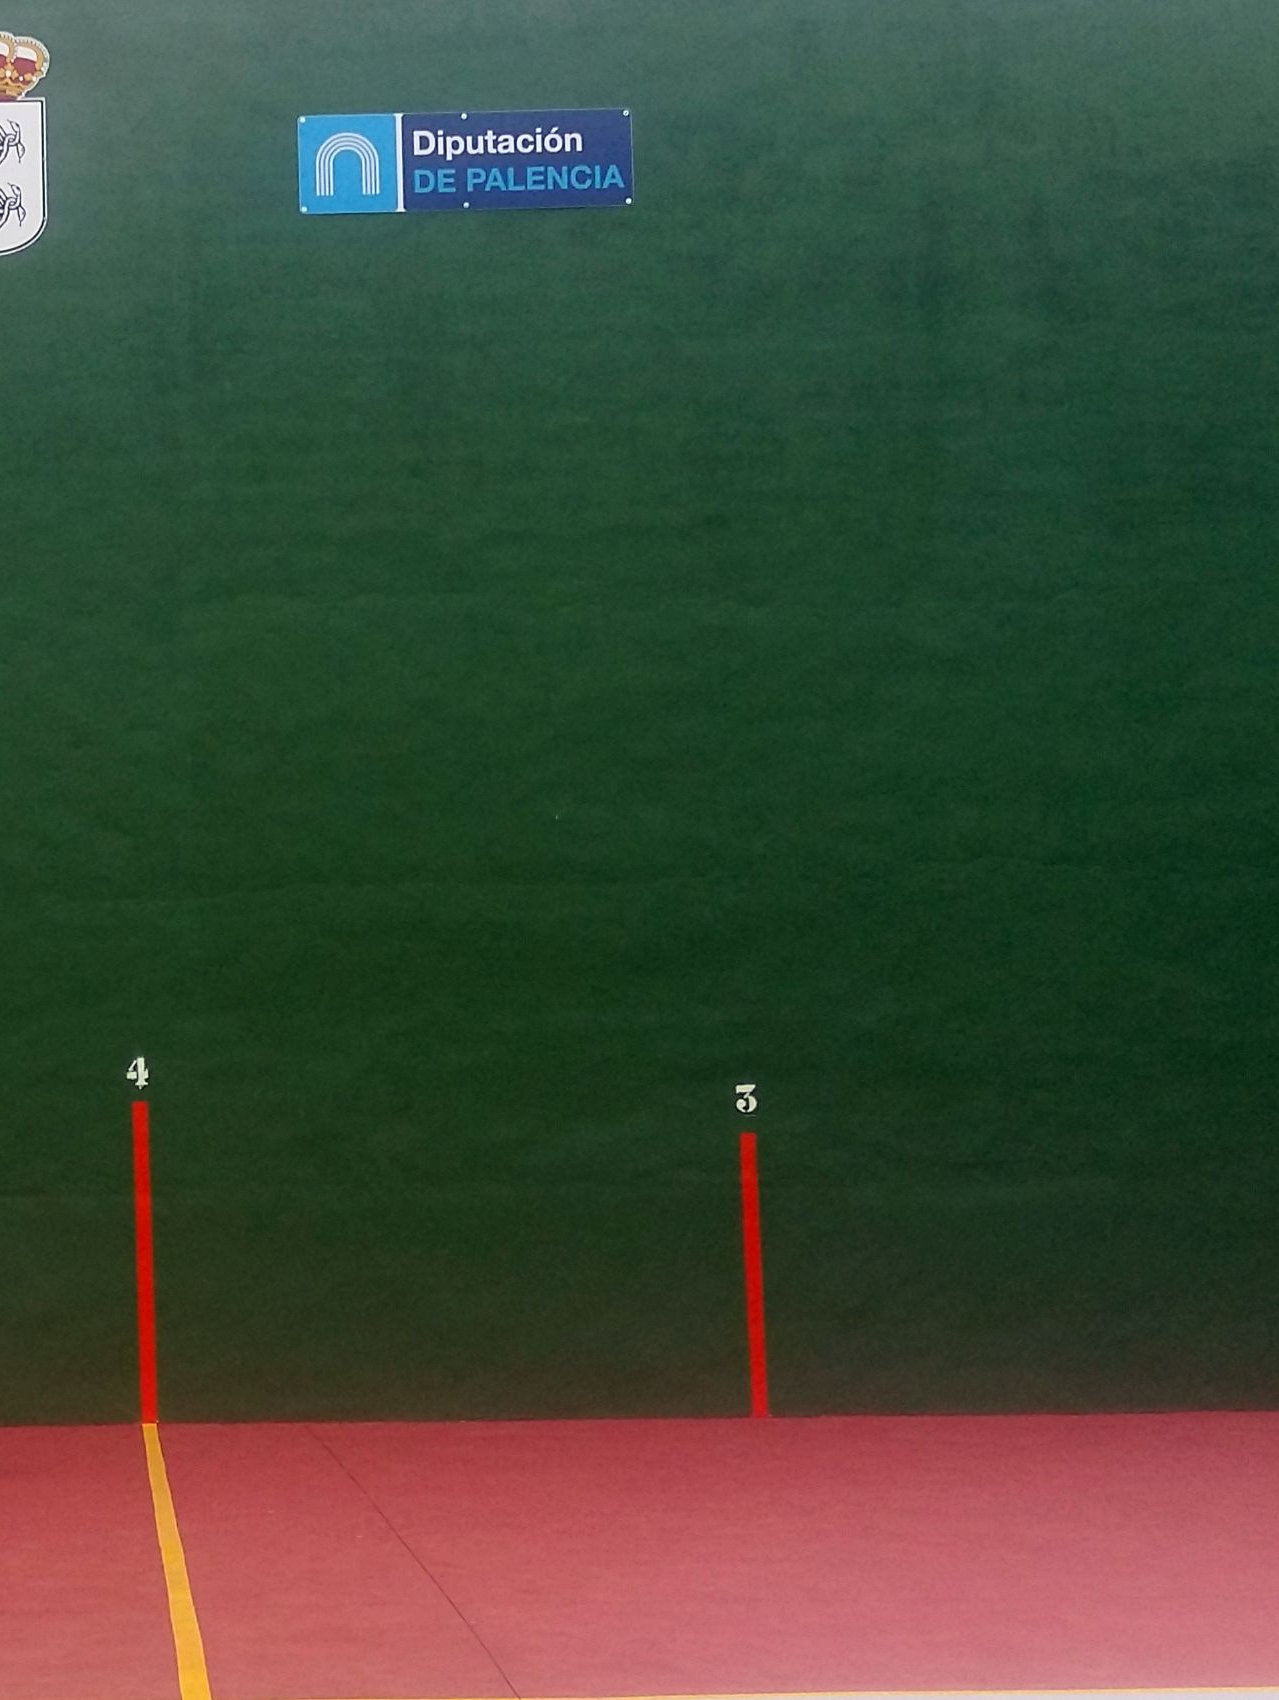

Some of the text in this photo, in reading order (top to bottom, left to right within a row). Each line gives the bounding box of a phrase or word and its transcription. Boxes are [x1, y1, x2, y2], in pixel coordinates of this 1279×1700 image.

[413, 127, 583, 160] Diputación
[413, 165, 625, 194] DE PALENCIA
[127, 1056, 149, 1090] 4
[735, 1084, 758, 1113] 3
